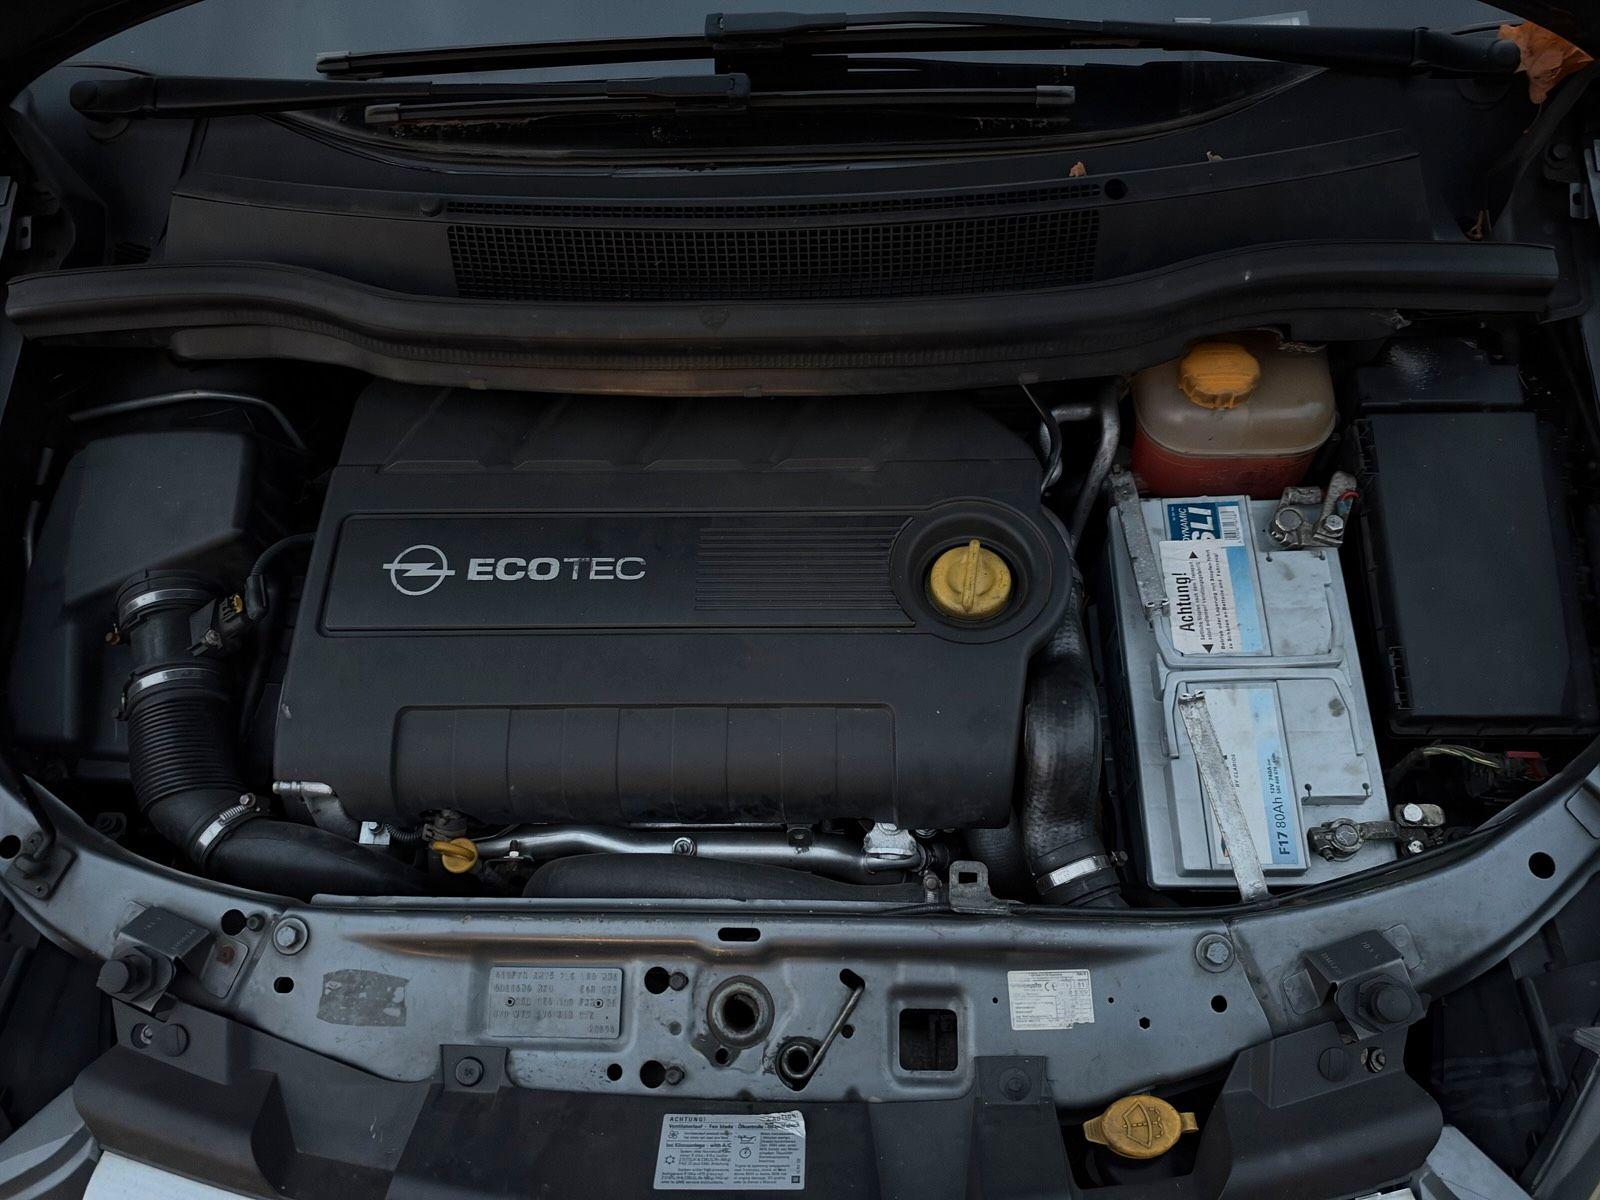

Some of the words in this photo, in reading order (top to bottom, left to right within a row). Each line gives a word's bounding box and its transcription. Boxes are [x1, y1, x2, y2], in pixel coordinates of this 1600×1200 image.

[467, 557, 646, 580] ECOTEC
[1172, 572, 1195, 632] Achtung!
[1272, 797, 1286, 828] 80Ah
[1277, 832, 1290, 855] F17
